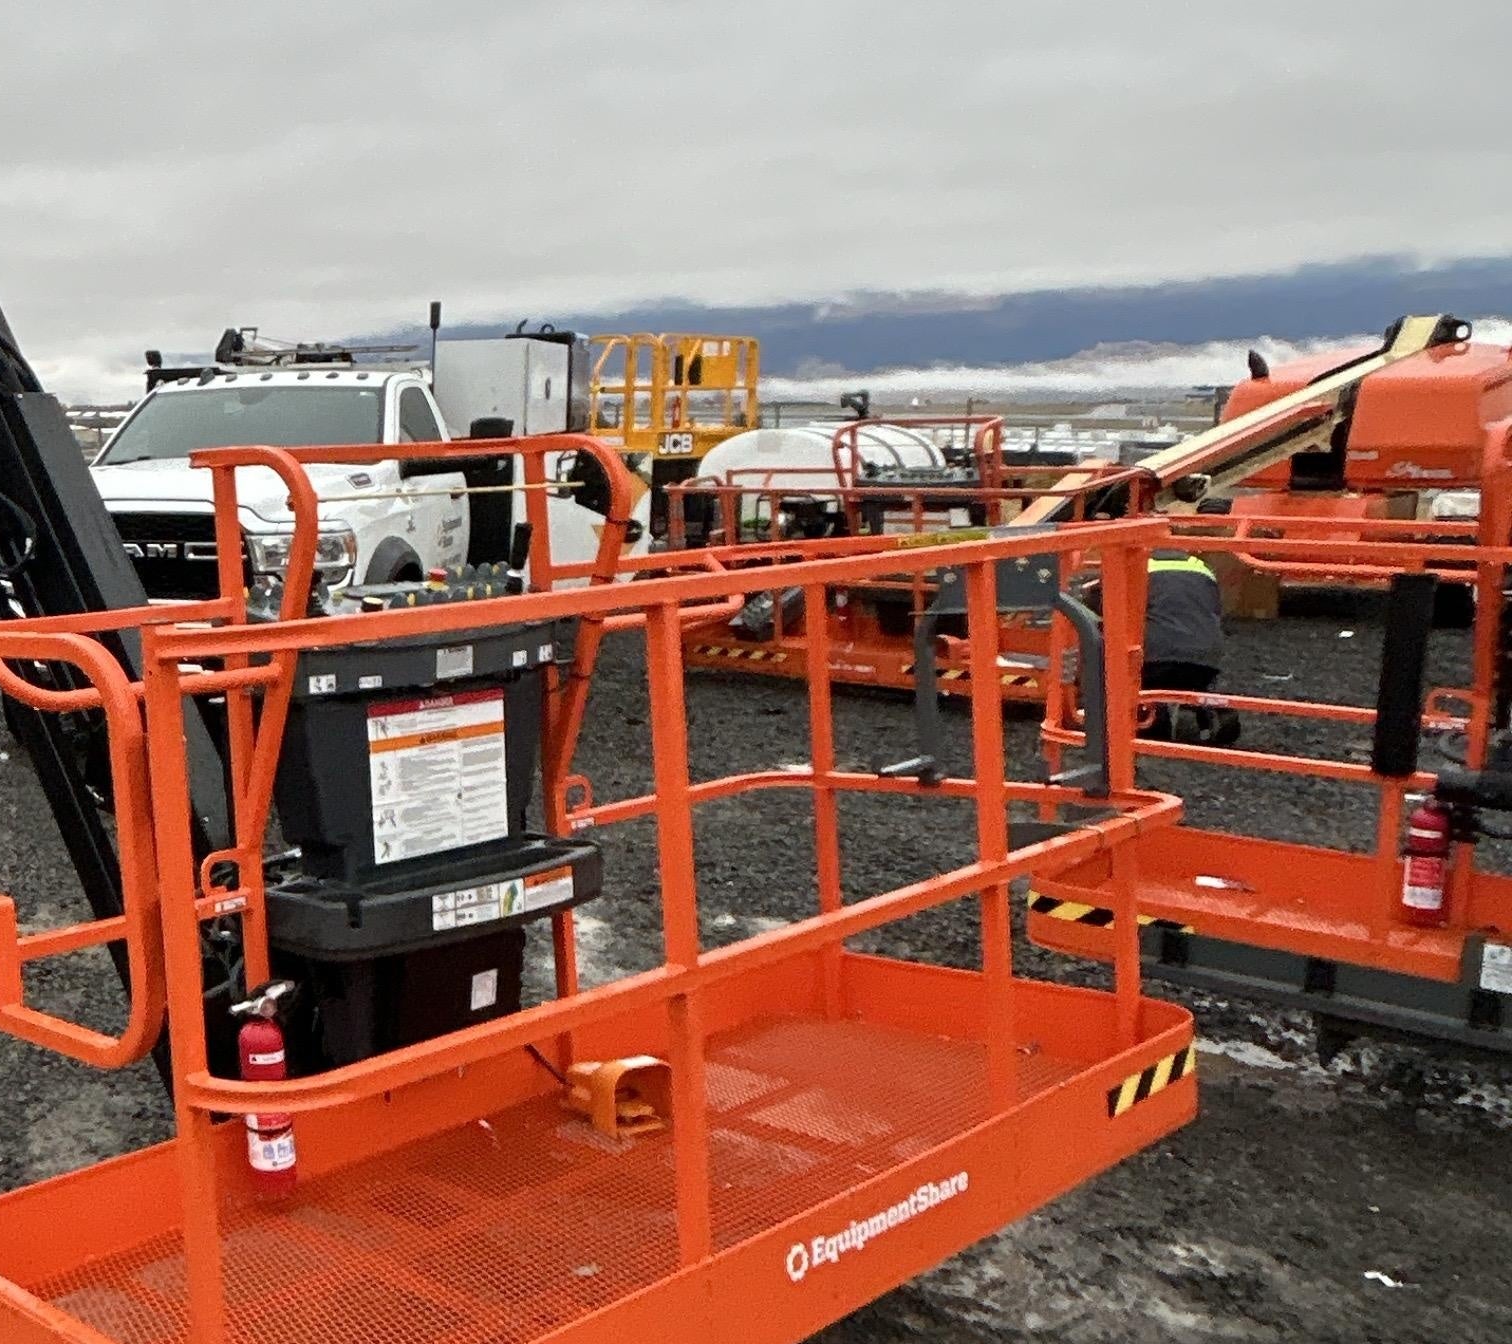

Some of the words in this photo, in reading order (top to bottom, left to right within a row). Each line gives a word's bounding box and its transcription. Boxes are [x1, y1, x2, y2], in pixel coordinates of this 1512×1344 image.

[658, 433, 693, 455] JCB
[121, 542, 178, 558] AM
[811, 1171, 969, 1268] EquipmentShare
